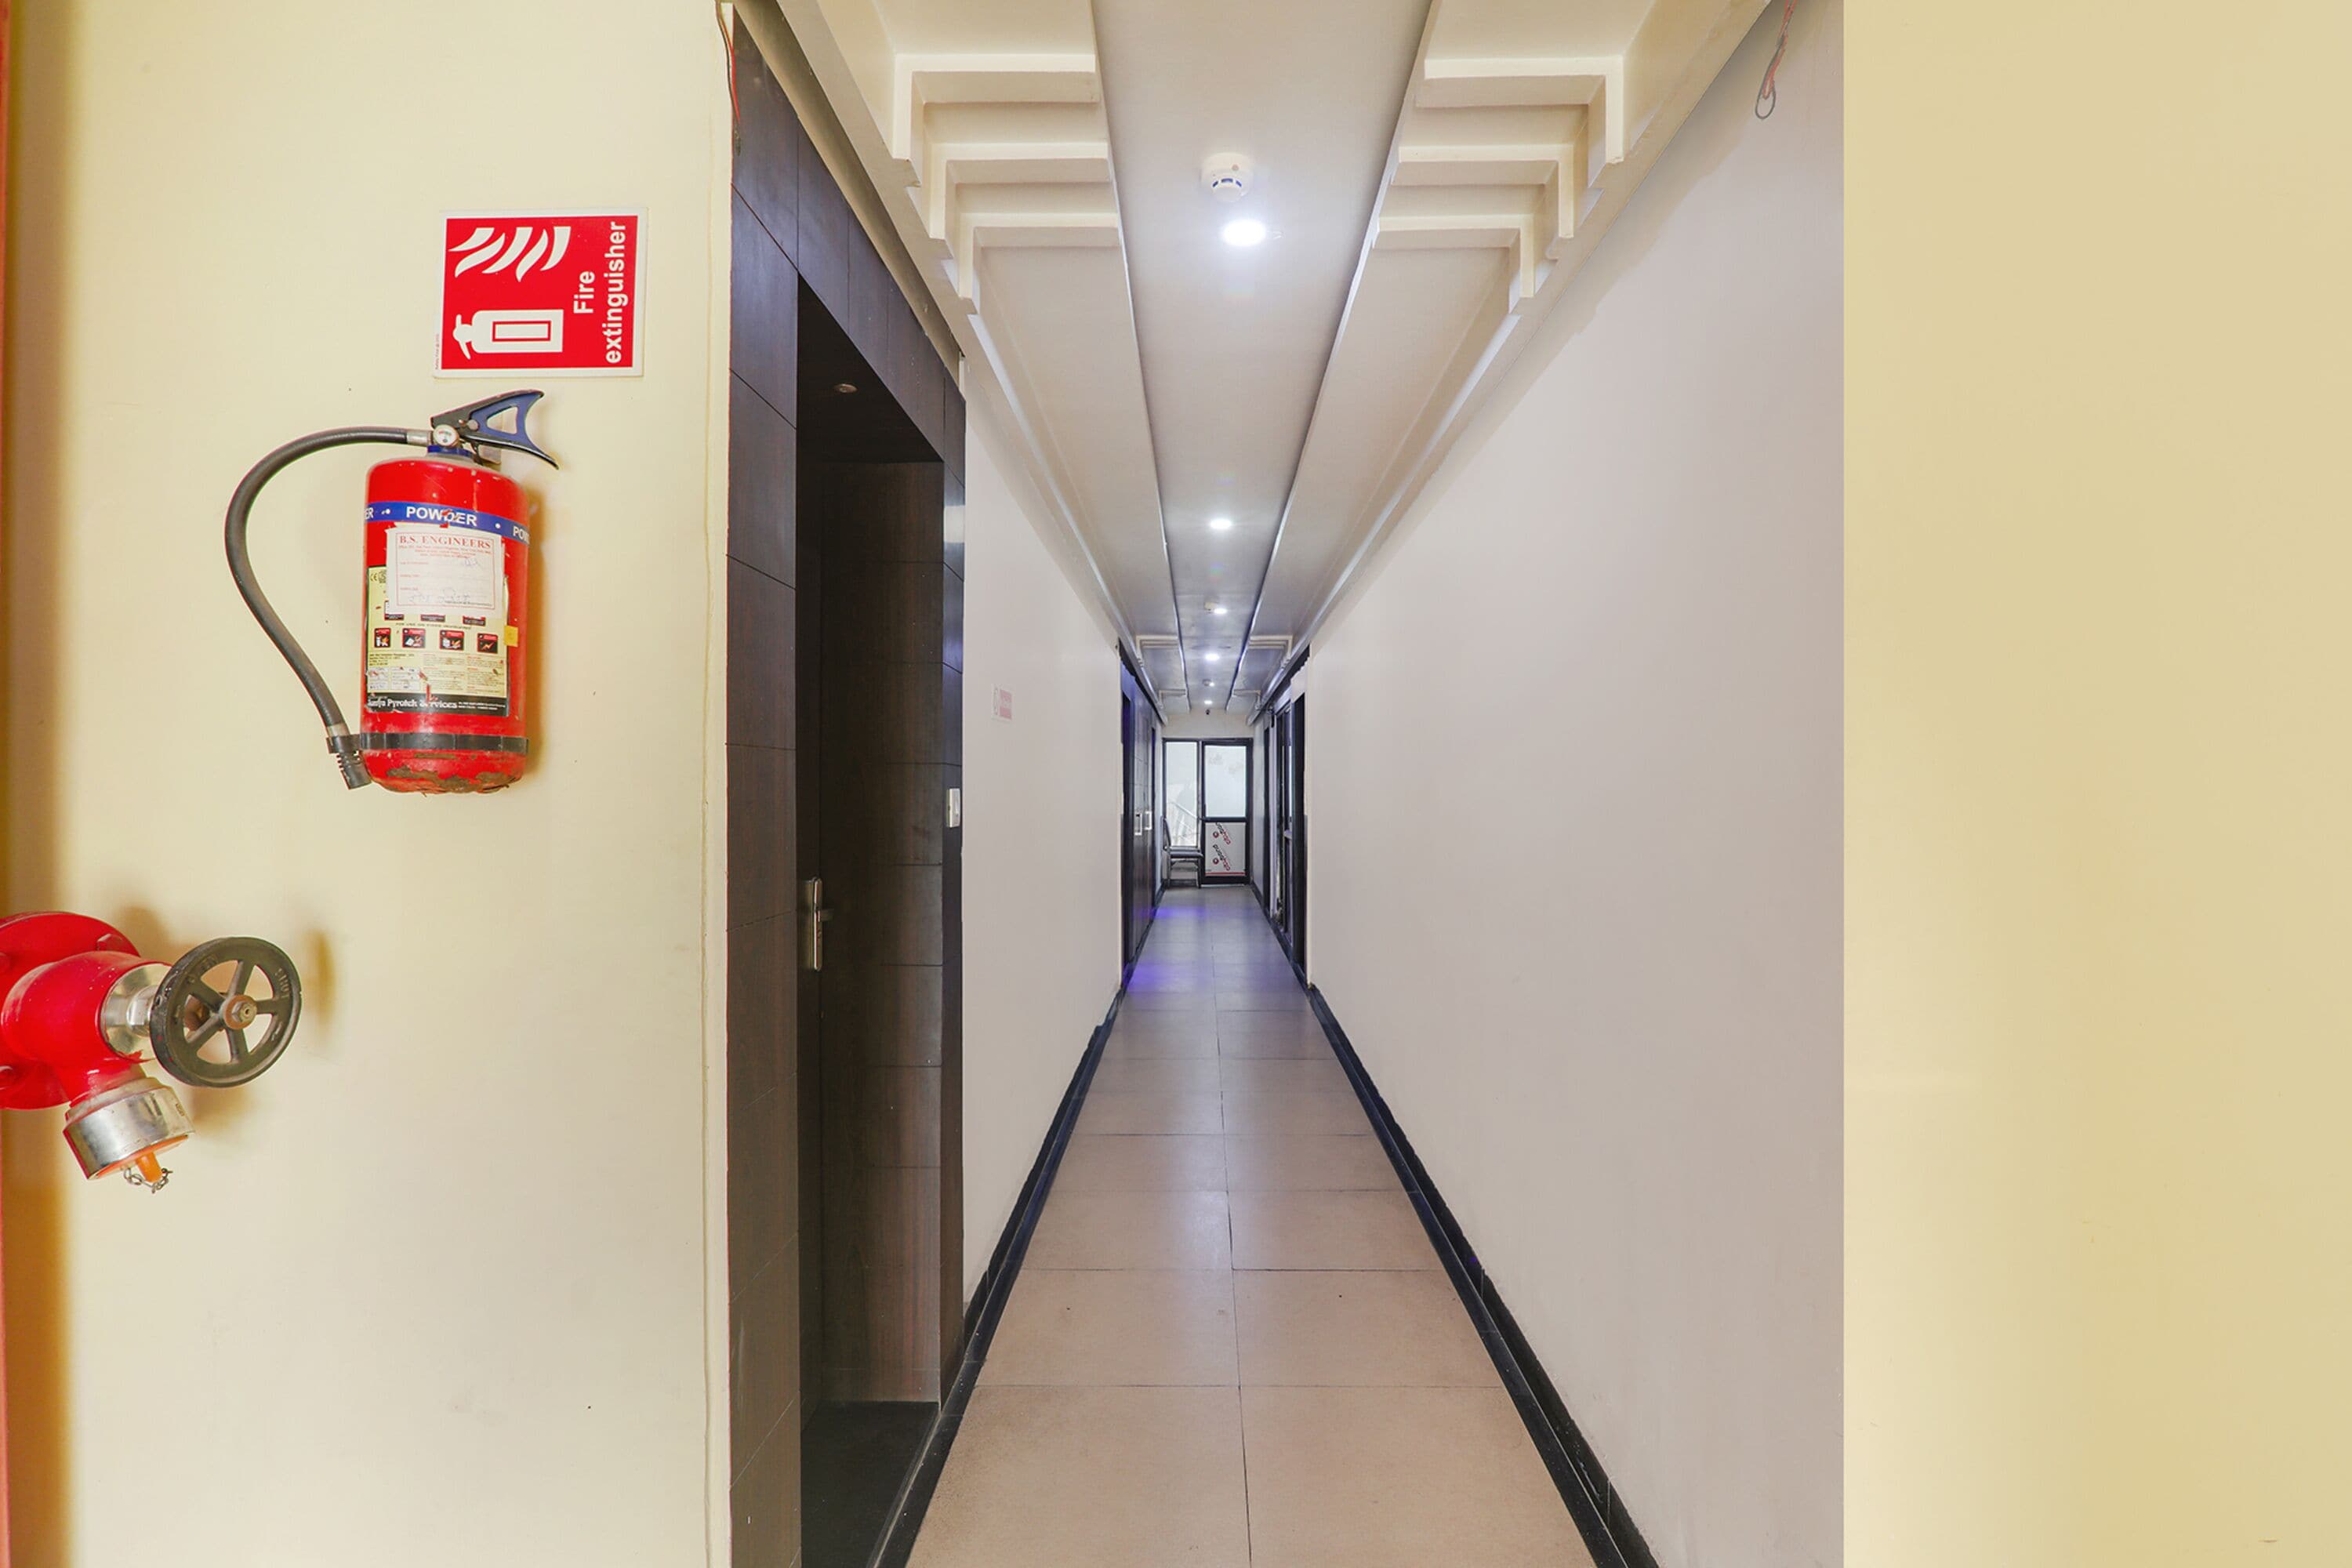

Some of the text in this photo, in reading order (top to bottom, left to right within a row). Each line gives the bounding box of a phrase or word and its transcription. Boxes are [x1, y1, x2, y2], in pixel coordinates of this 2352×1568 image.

[573, 271, 595, 314] Fire
[602, 221, 628, 363] extinguisher
[406, 506, 477, 526] POWDER
[421, 535, 491, 548] ENGINEERS
